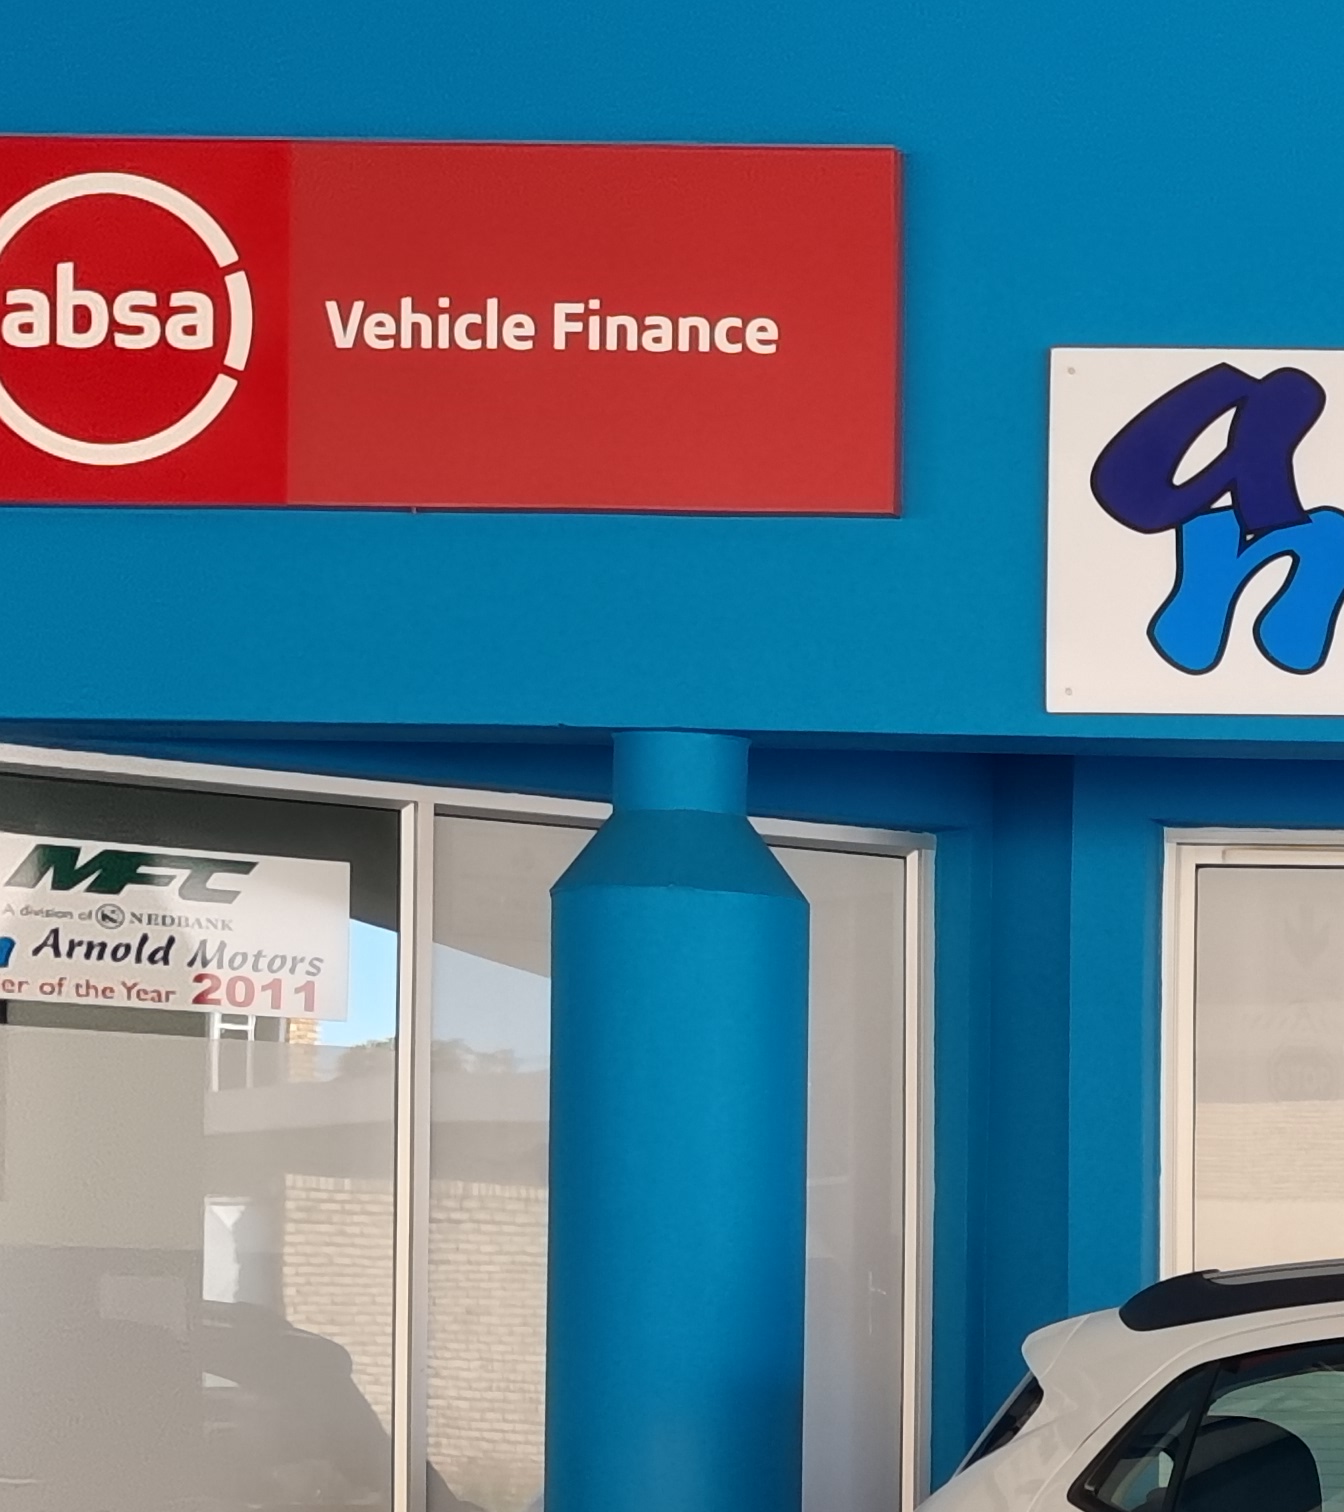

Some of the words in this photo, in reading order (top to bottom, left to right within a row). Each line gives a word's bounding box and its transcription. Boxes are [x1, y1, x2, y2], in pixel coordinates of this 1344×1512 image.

[2, 262, 215, 349] absa
[326, 297, 535, 352] Vehicle
[553, 299, 780, 355] Finance
[4, 843, 260, 904] MFC
[20, 904, 74, 920] division
[78, 908, 93, 922] of
[130, 911, 234, 932] NEDBANK
[32, 927, 176, 967] Arnold
[187, 938, 324, 978] Motors
[39, 977, 67, 996] of
[75, 979, 116, 999] the
[121, 980, 177, 1004] Year
[192, 972, 316, 1013] 2011
